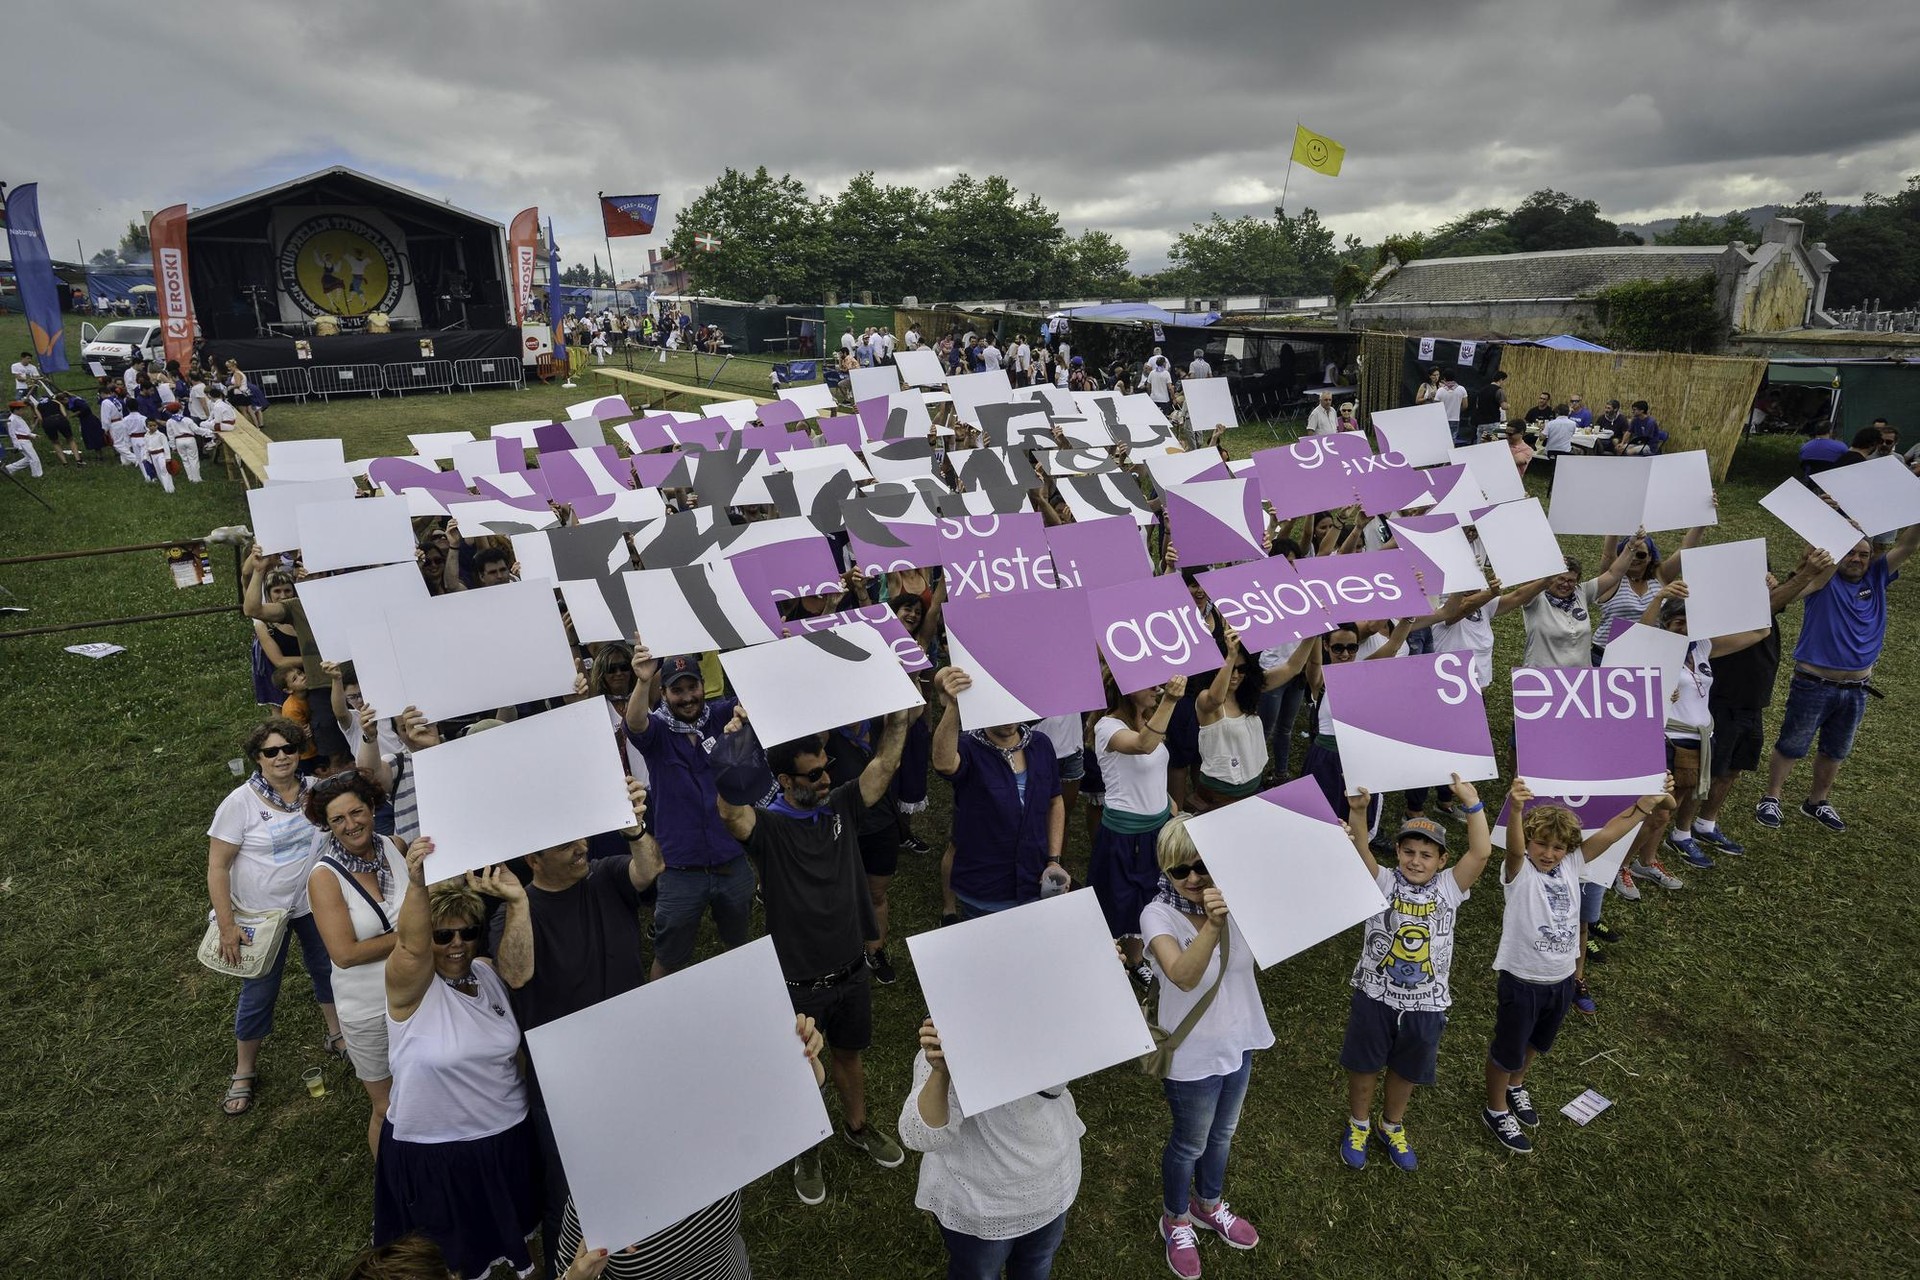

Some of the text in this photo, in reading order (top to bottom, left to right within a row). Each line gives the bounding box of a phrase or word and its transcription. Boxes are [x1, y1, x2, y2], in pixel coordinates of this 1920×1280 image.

[165, 253, 183, 312] EROSKI
[521, 251, 531, 301] EROSKI
[1386, 989, 1432, 1000] MINION
